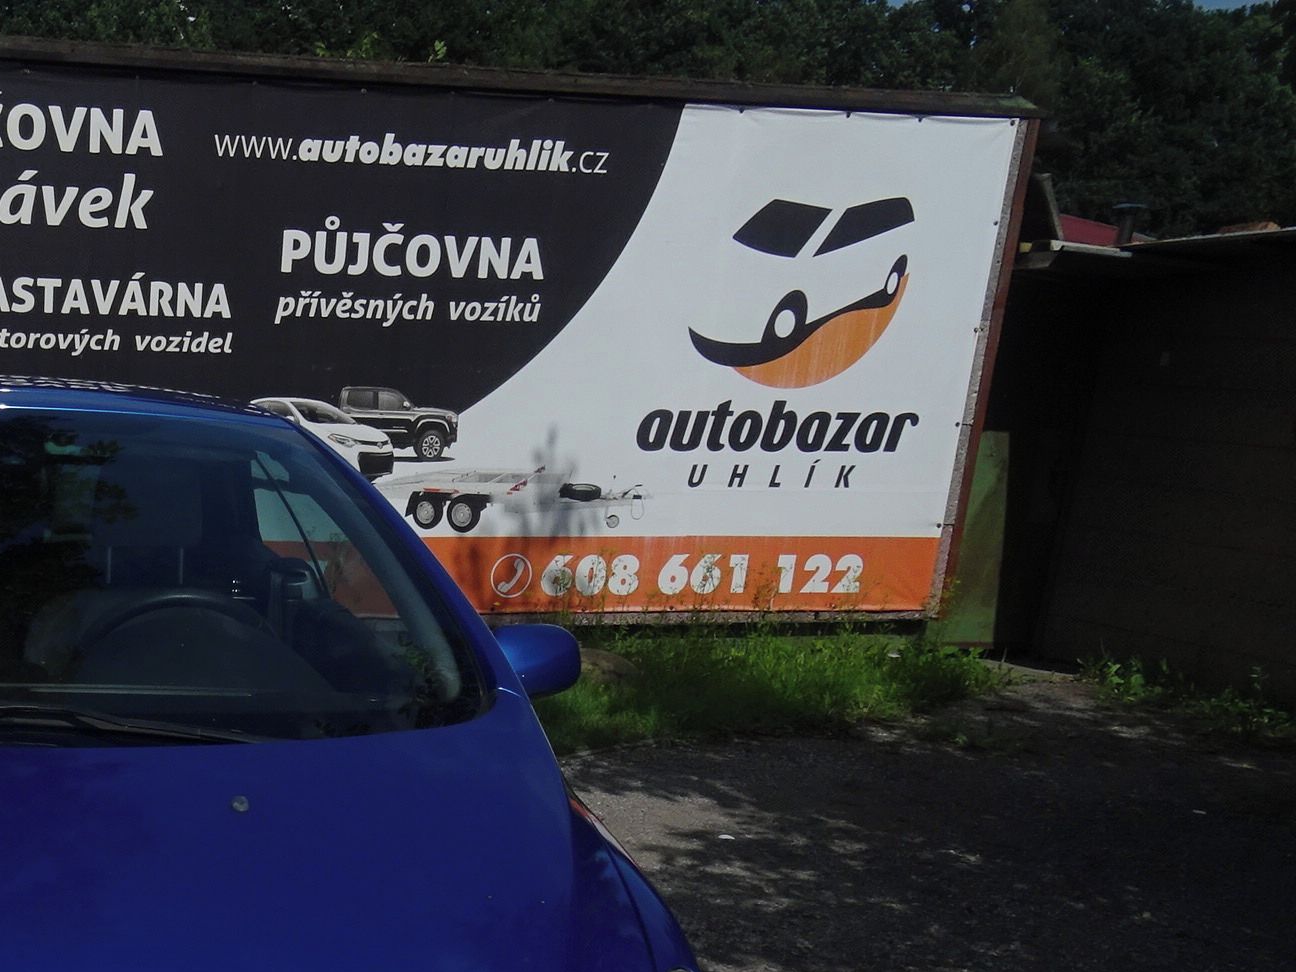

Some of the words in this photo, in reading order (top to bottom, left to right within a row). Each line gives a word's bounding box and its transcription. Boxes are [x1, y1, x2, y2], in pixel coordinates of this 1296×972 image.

[214, 133, 609, 174] www.autobazaruhlik.cz
[280, 216, 544, 280] PŮJČOVNA
[275, 291, 434, 327] přívěsných
[449, 294, 541, 323] vozíků
[135, 332, 233, 354] vozidel
[636, 400, 919, 453] autobazar
[687, 459, 856, 488] UHLÍK
[541, 554, 640, 597] 608
[658, 554, 749, 595] 661
[778, 554, 864, 594] 122
